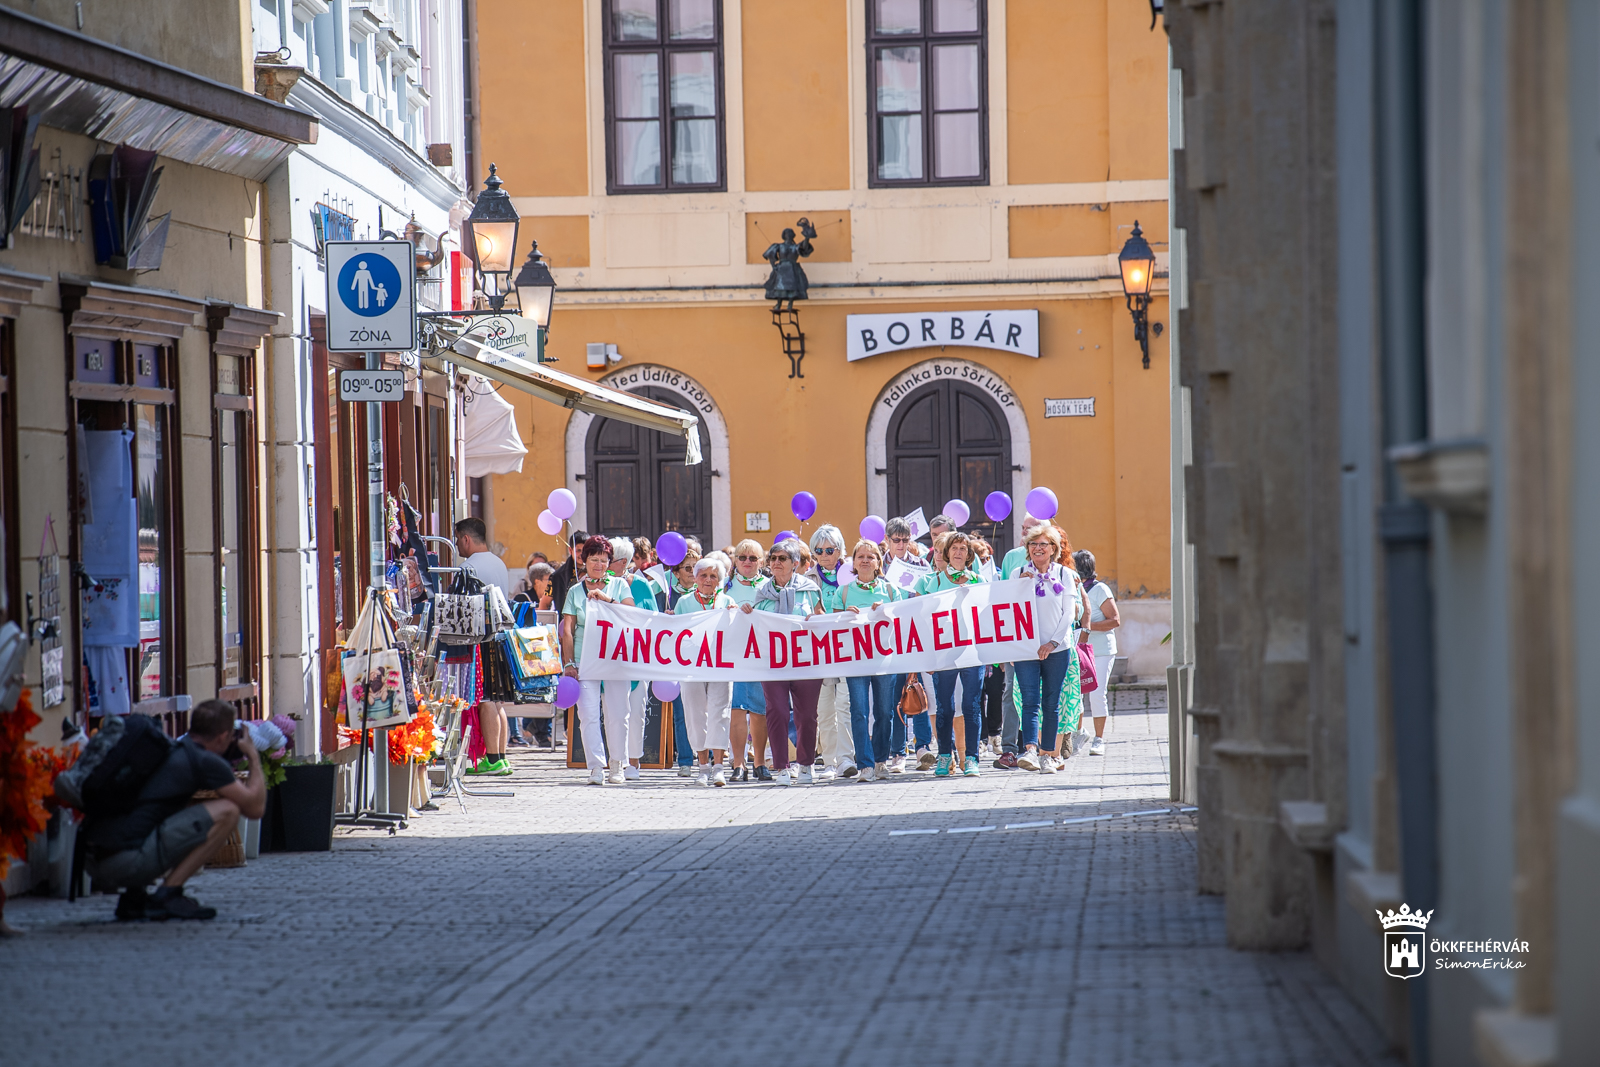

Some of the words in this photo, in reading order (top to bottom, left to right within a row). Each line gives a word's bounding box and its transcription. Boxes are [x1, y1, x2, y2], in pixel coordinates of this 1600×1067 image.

[349, 326, 392, 342] ZÓNA
[860, 312, 1022, 352] BORBÁR
[934, 364, 958, 377] Bor
[611, 372, 638, 389] Tea
[681, 380, 713, 414] Szörp
[1074, 403, 1092, 414] TERE
[596, 619, 735, 669] TÁNCCAL
[743, 623, 762, 659] A
[769, 616, 924, 670] DEMENCIA
[932, 600, 1035, 651] ELLEN
